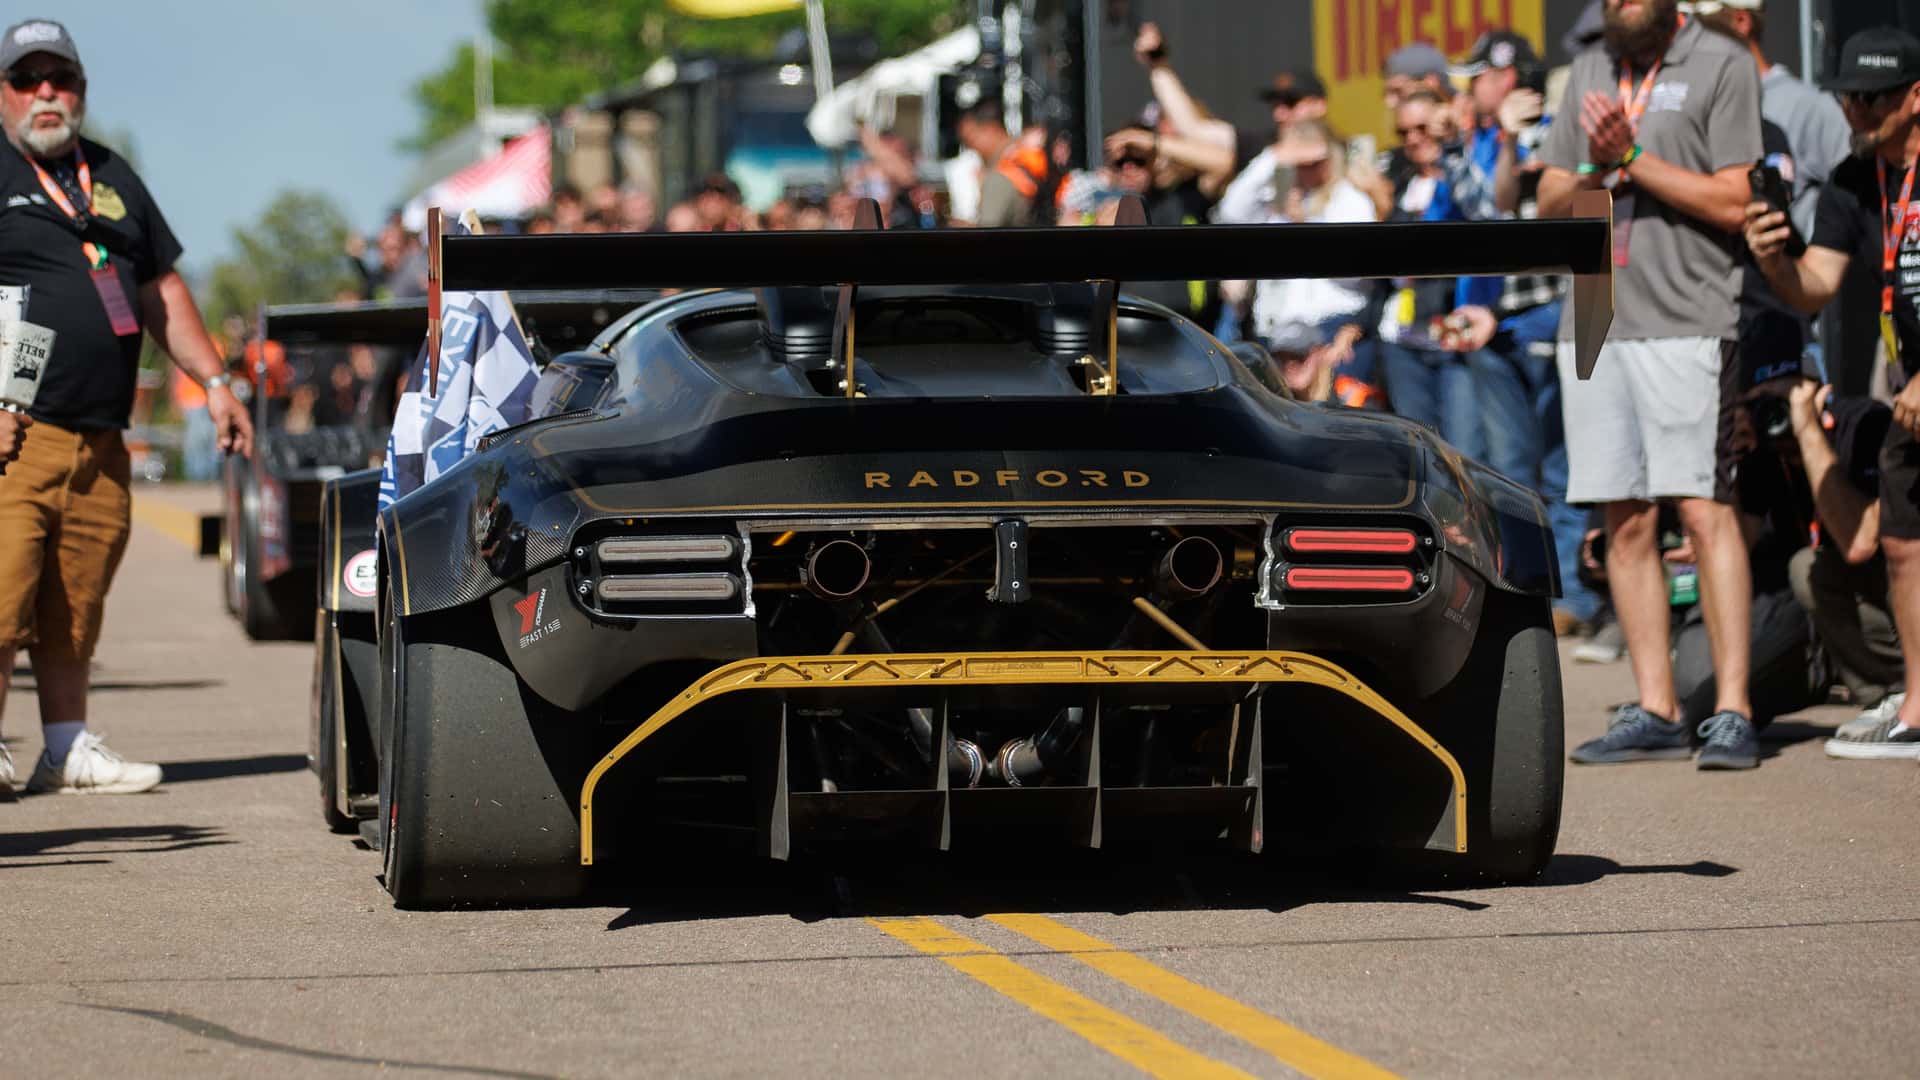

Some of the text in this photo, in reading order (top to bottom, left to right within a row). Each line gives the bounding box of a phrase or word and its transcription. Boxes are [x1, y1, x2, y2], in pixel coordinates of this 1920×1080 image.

[18, 342, 46, 359] BELL
[865, 470, 1150, 489] RADFORD
[525, 623, 553, 645] FAST 15
